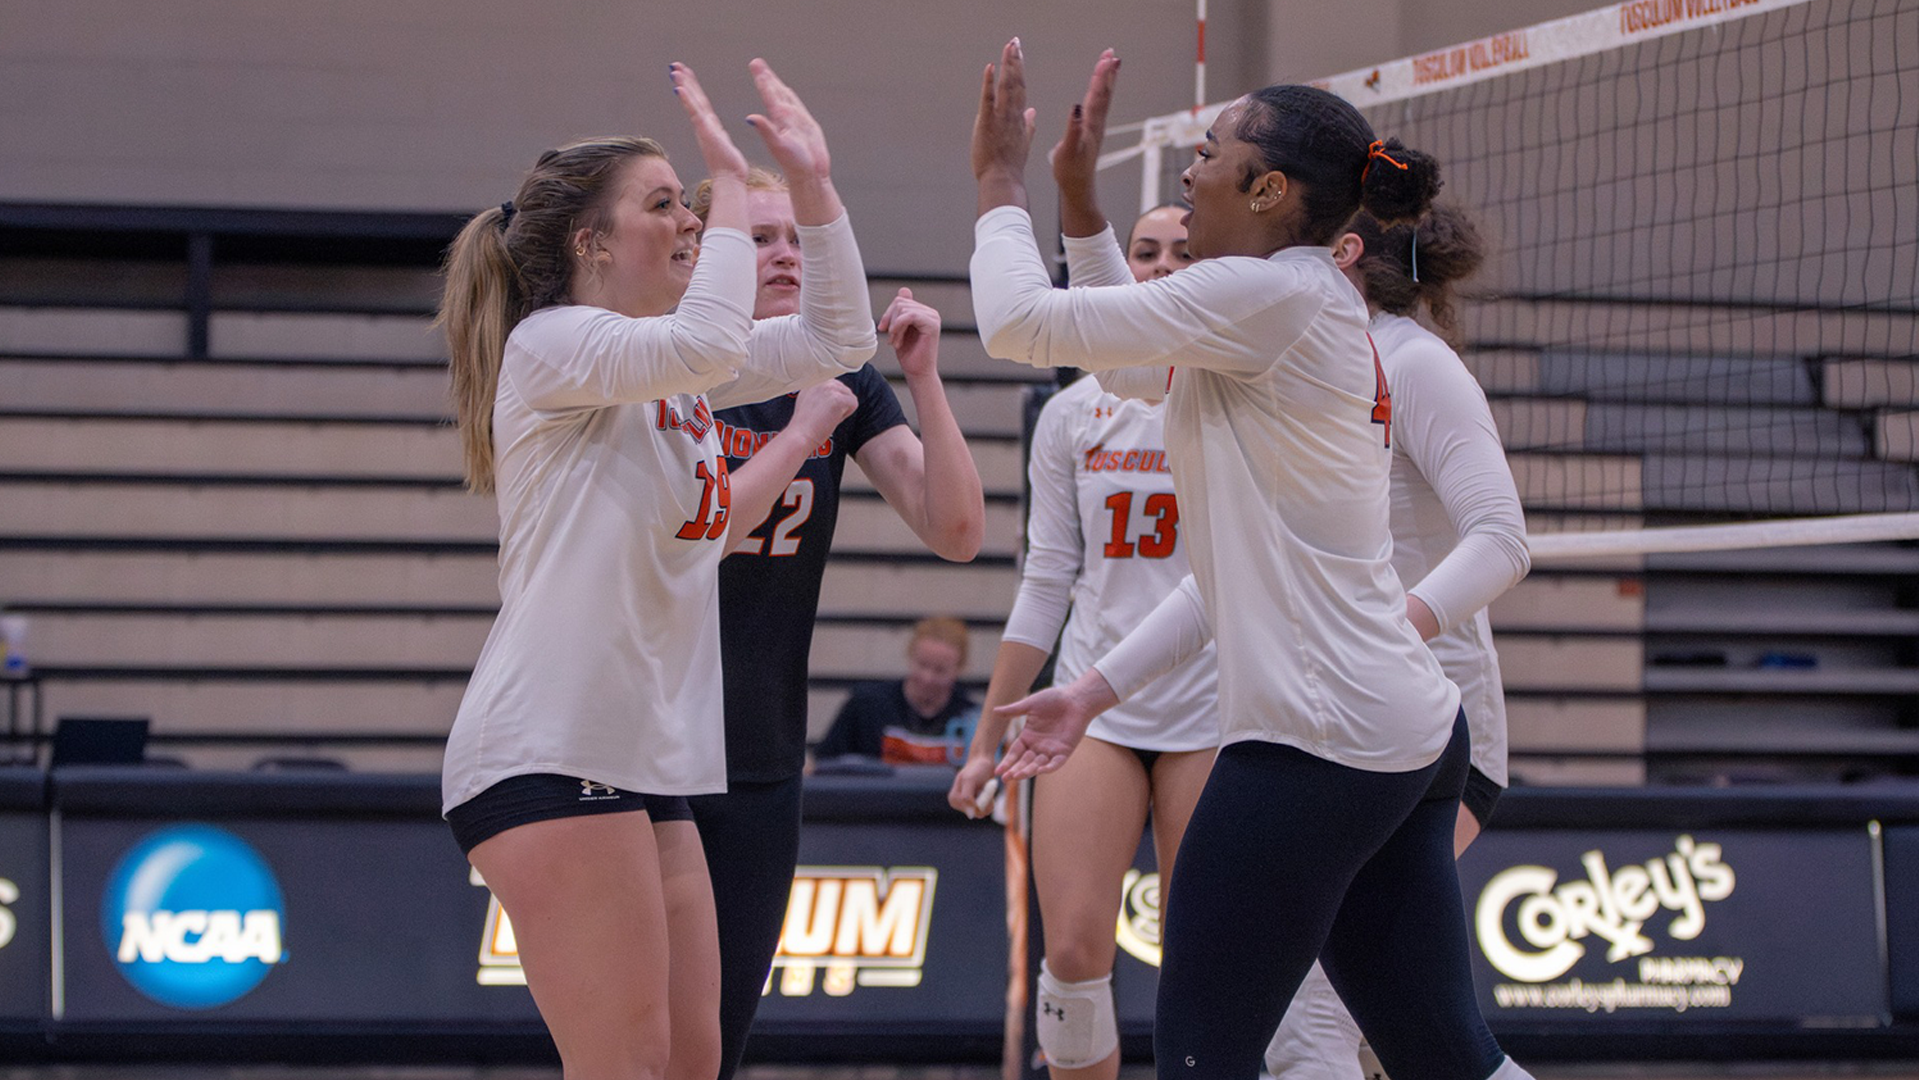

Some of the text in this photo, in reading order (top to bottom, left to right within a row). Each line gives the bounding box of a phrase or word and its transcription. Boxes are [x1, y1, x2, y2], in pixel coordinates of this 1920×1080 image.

[1083, 443, 1172, 474] TUSCUL
[675, 454, 732, 541] 19
[731, 477, 815, 557] 2
[1103, 491, 1180, 559] 13
[117, 909, 282, 964] NCAA
